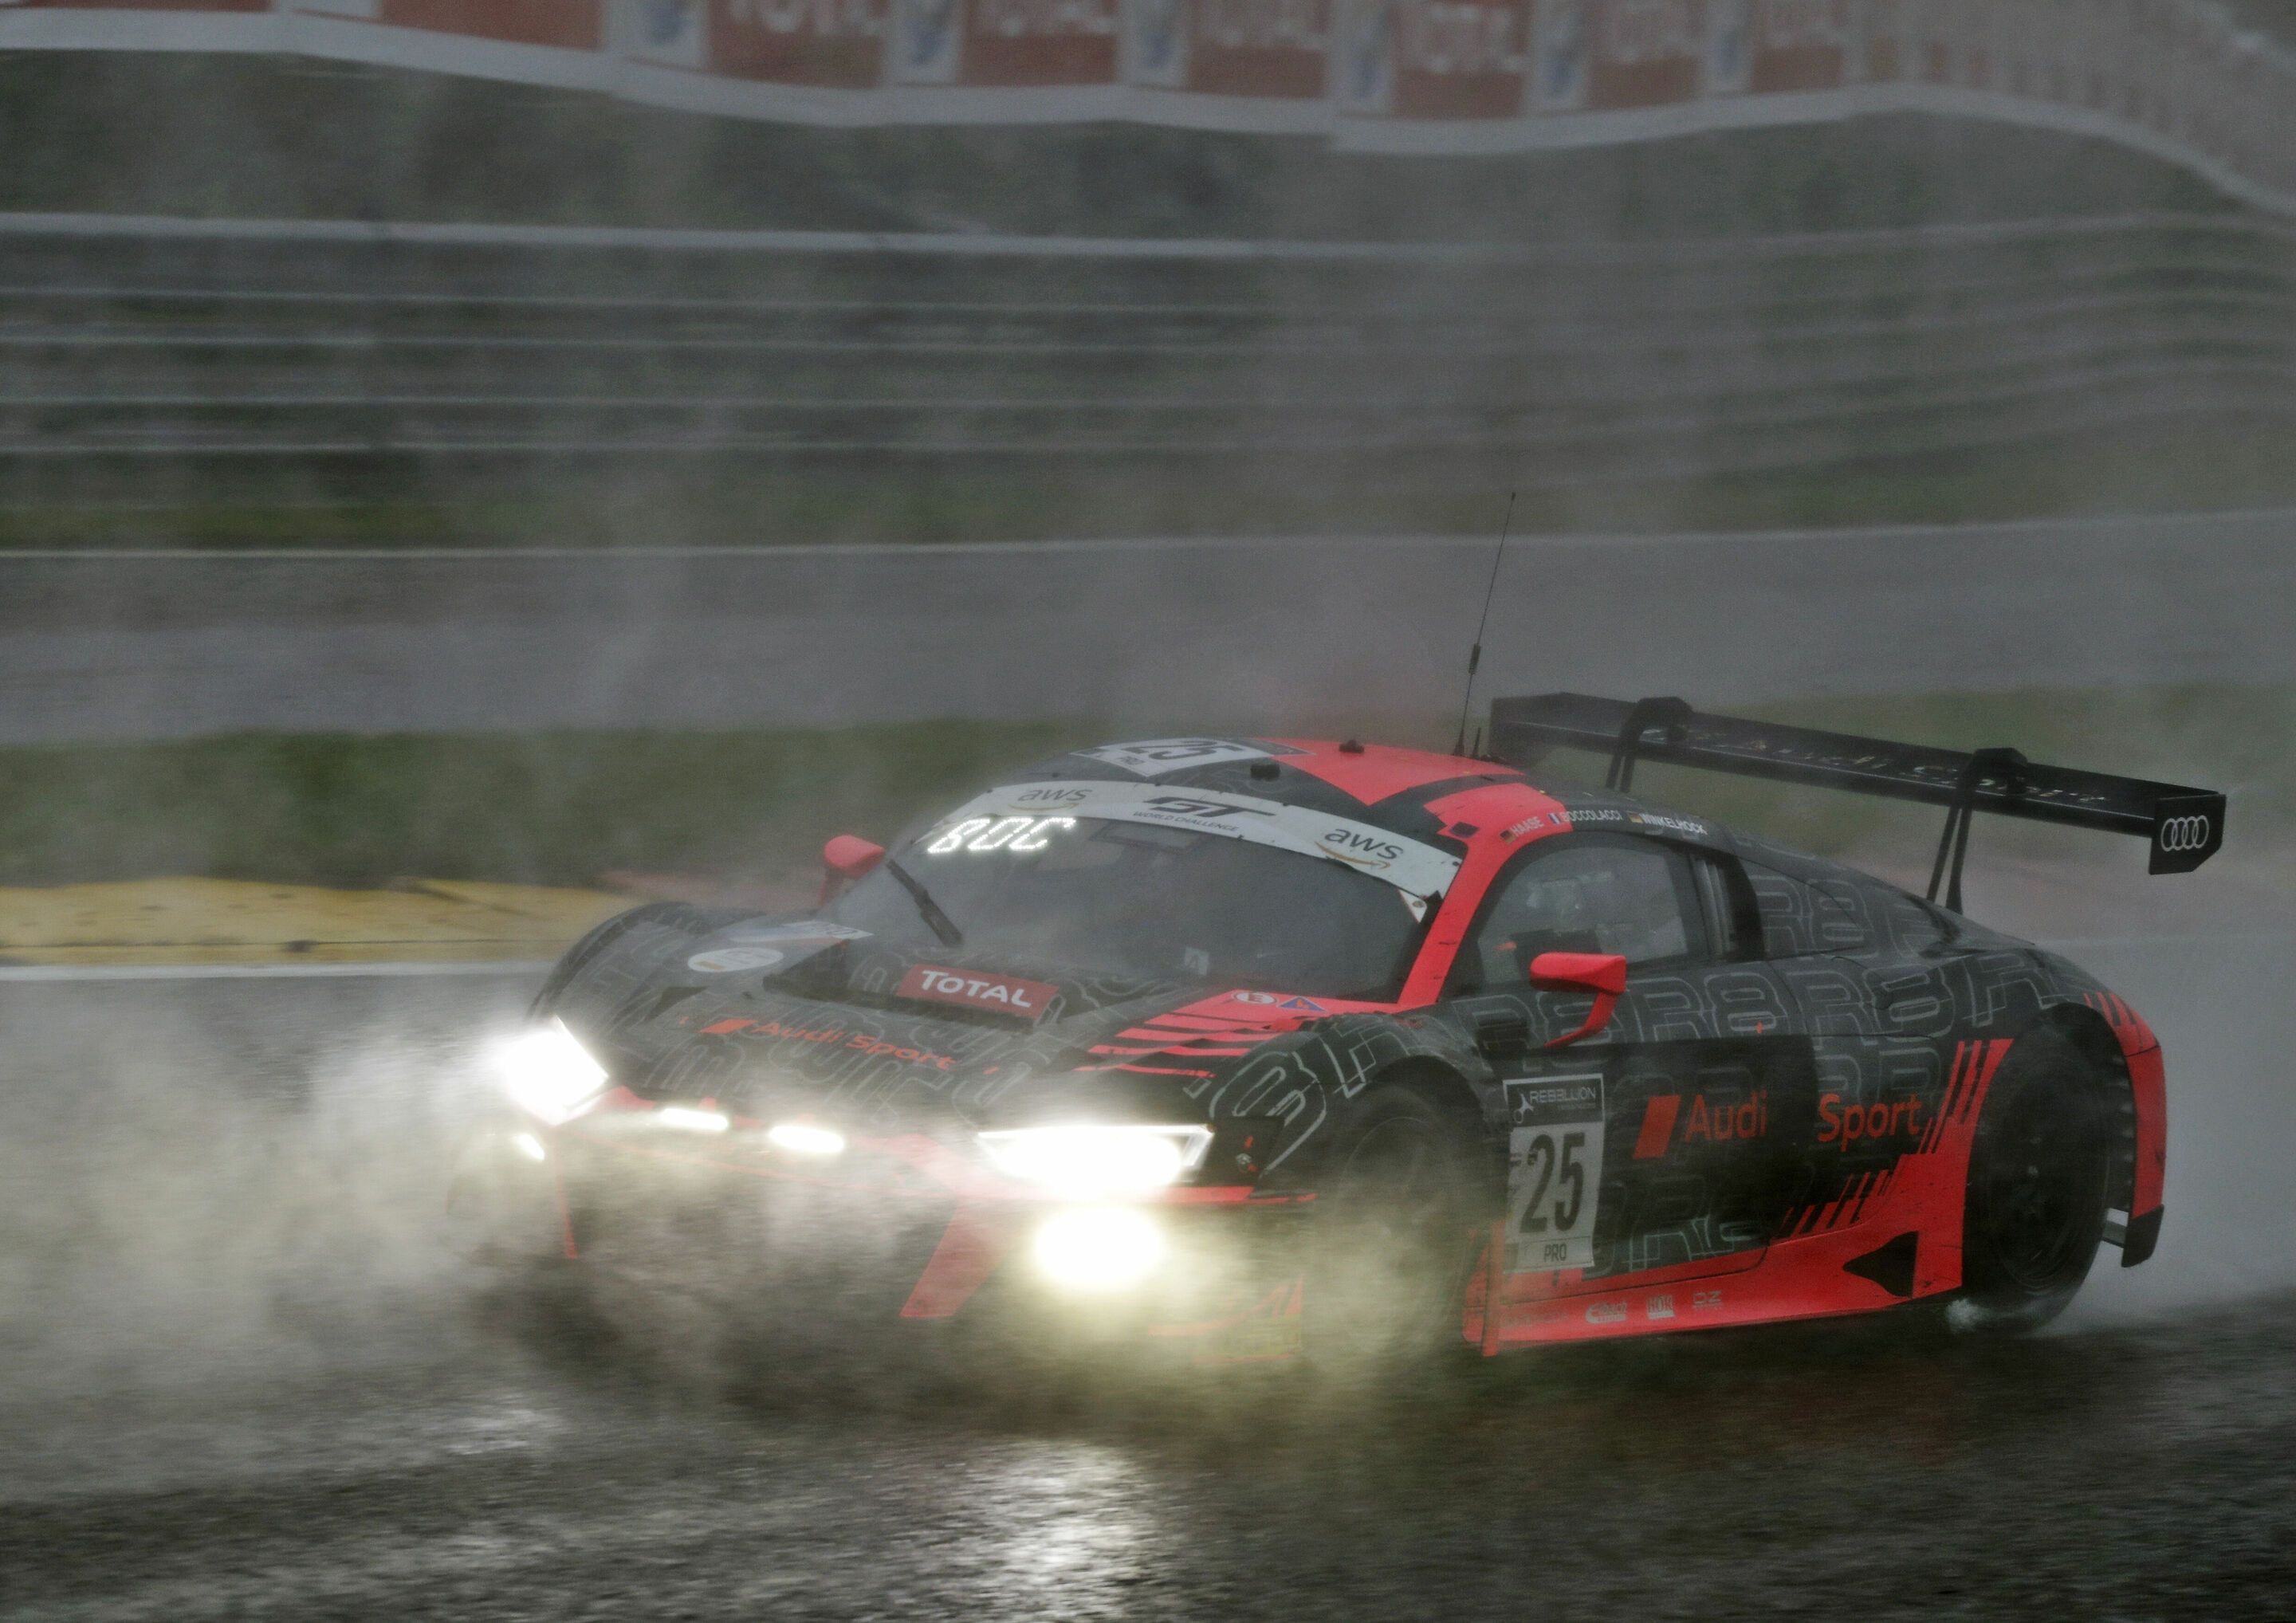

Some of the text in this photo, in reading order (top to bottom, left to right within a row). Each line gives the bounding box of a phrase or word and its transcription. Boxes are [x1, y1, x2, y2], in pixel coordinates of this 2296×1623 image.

[1017, 788, 1092, 801] aws
[1133, 811, 1239, 831] WORLD CHALLENGE
[1511, 815, 1544, 836] HAASE
[1324, 828, 1404, 860] aws
[921, 969, 1032, 1008] TOTAL
[752, 1022, 956, 1070] Audi Sport
[1529, 1086, 1596, 1105] REBELLION
[1684, 1092, 1923, 1153] Audi Sport
[1519, 1132, 1586, 1234] 25
[1543, 1243, 1567, 1263] PRO
